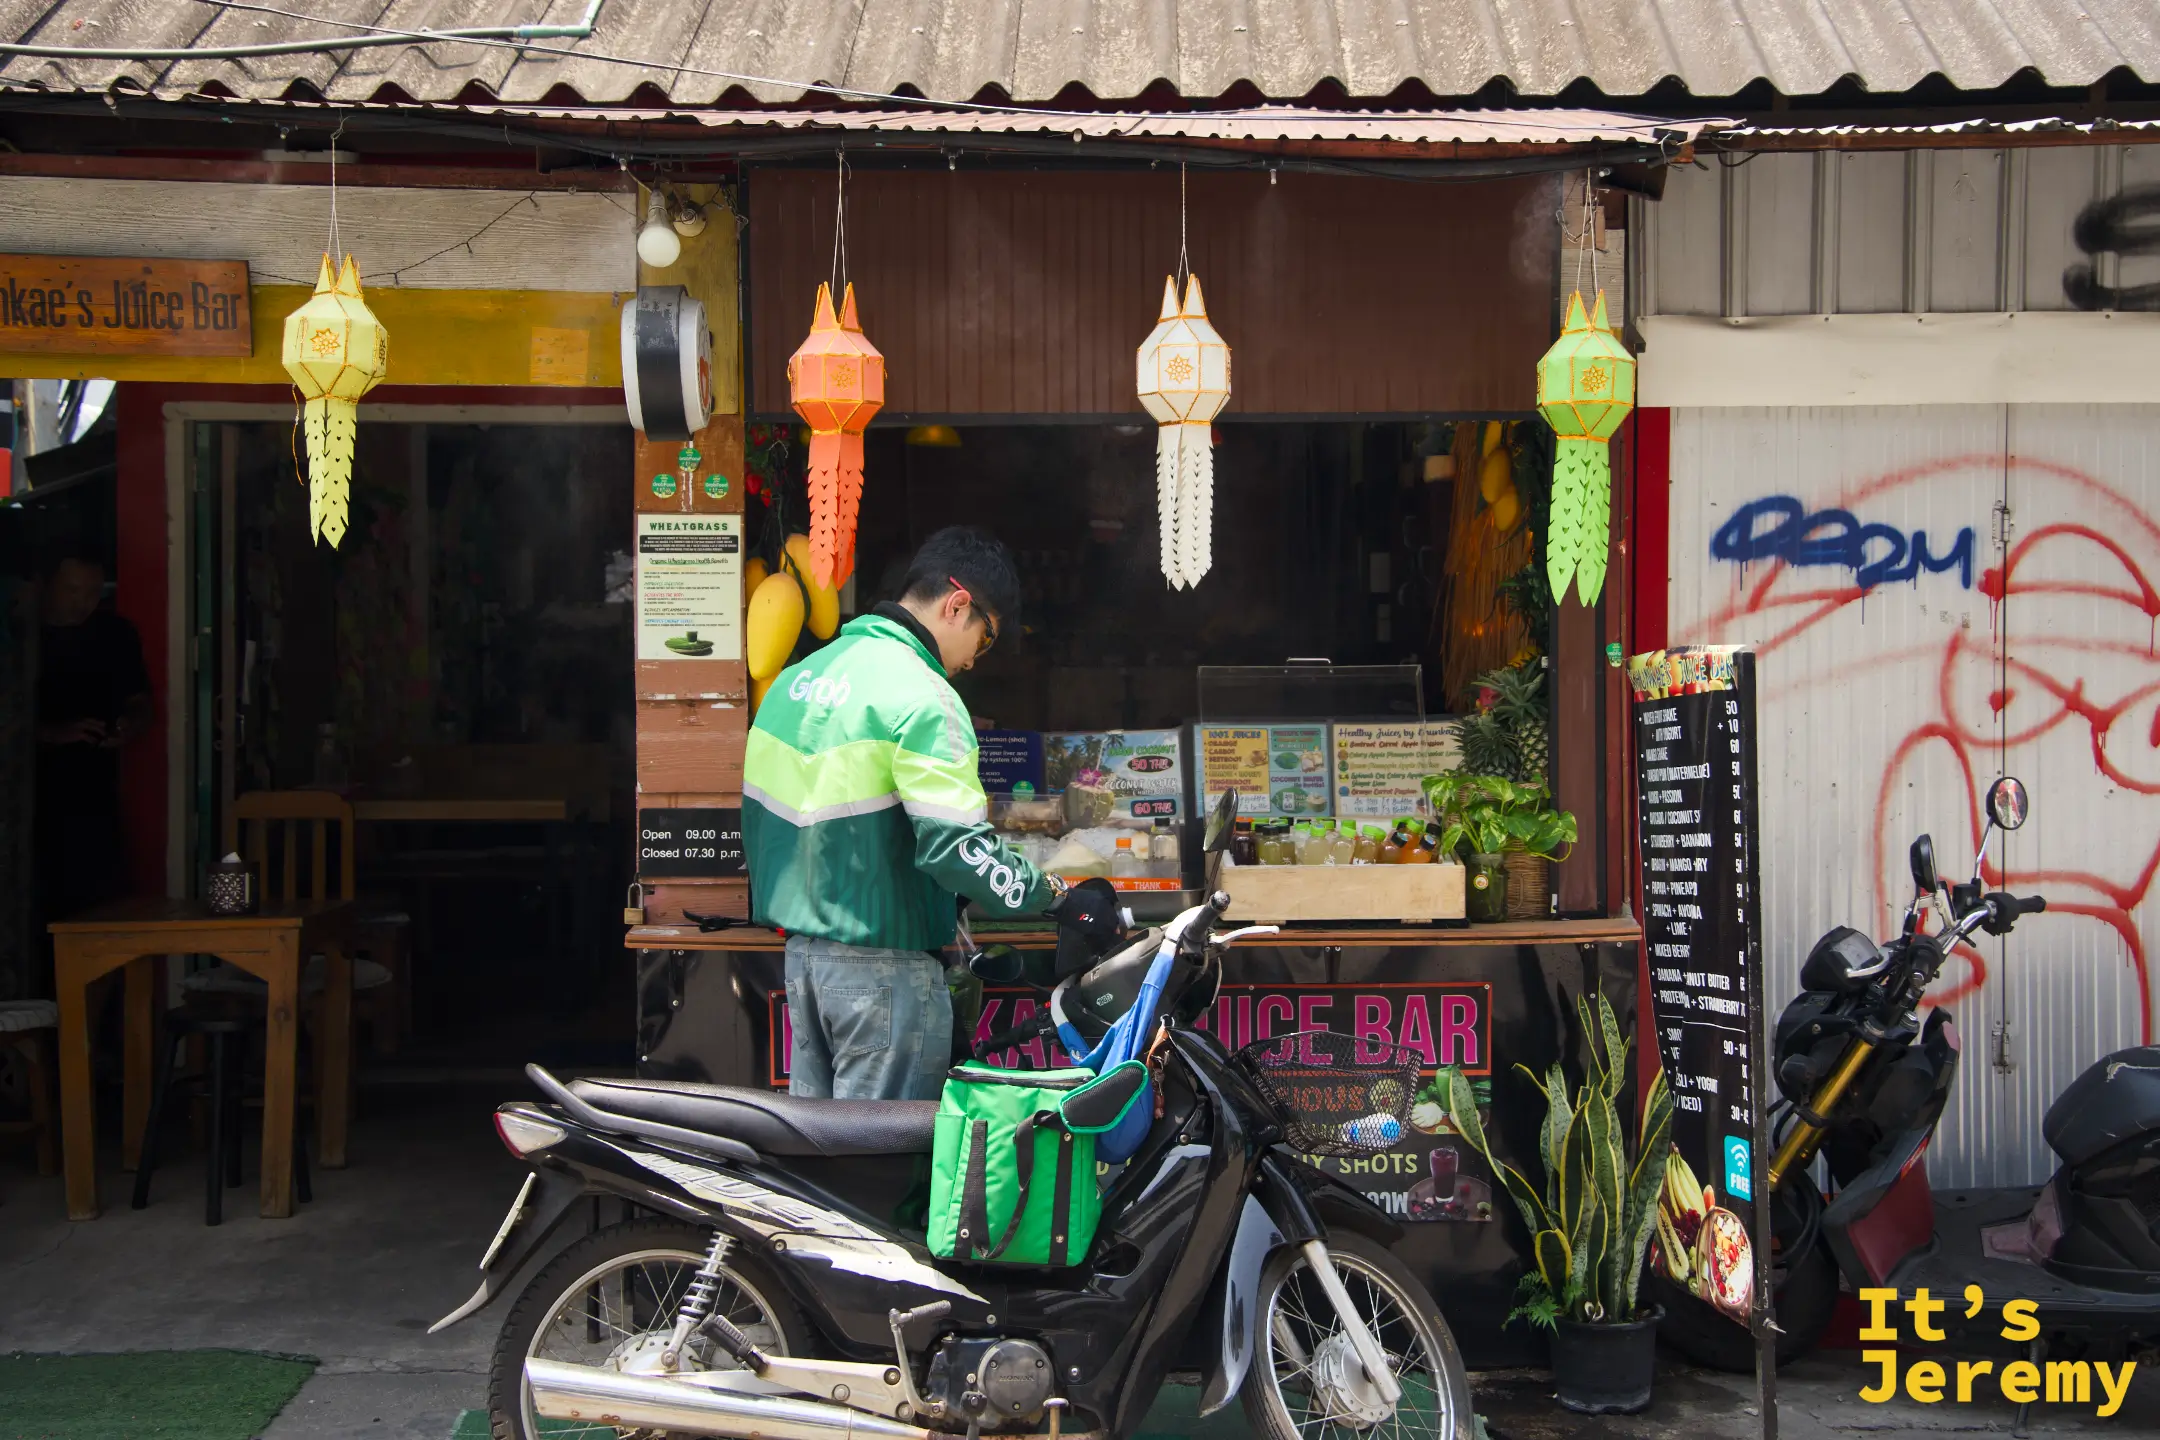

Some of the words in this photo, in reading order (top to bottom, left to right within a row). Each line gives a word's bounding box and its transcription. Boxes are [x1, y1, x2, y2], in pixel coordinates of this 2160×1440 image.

[104, 280, 184, 329] Juice
[192, 281, 241, 330] Bar
[650, 522, 728, 530] WHEATGRASS
[1678, 656, 1708, 685] JUICE
[789, 670, 851, 706] Grab
[1726, 700, 1737, 715] 50
[1728, 719, 1738, 733] 10
[1338, 728, 1372, 740] Healthy
[1376, 728, 1400, 739] Juices
[1404, 729, 1414, 739] by
[1730, 739, 1739, 754] 60
[1132, 758, 1147, 770] 50
[1105, 780, 1144, 790] COCONUT
[1662, 789, 1682, 803] PASSION
[1134, 802, 1151, 814] 60
[1668, 810, 1694, 824] COCONUT
[642, 830, 672, 841] Open
[686, 830, 716, 839] 09.00
[642, 848, 680, 858] Closed
[684, 848, 714, 858] 07.30
[1669, 858, 1692, 871] MANGO
[958, 836, 1026, 908] Grab
[1134, 882, 1161, 890] THANK
[1652, 903, 1672, 917] SPINACH
[1670, 922, 1688, 935] LIME
[1655, 944, 1671, 957] MIXED
[1657, 968, 1682, 982] BANANA
[1708, 973, 1730, 990] BUTTER
[1698, 996, 1739, 1016] STRAWBERRY
[1195, 994, 1333, 1066] UICE
[1354, 994, 1478, 1064] BAR
[1724, 1040, 1733, 1055] 90
[1681, 1095, 1702, 1112] ICED)
[1731, 1105, 1740, 1120] 30
[1340, 1154, 1418, 1174] SHOTS
[1730, 1172, 1750, 1194] FREE
